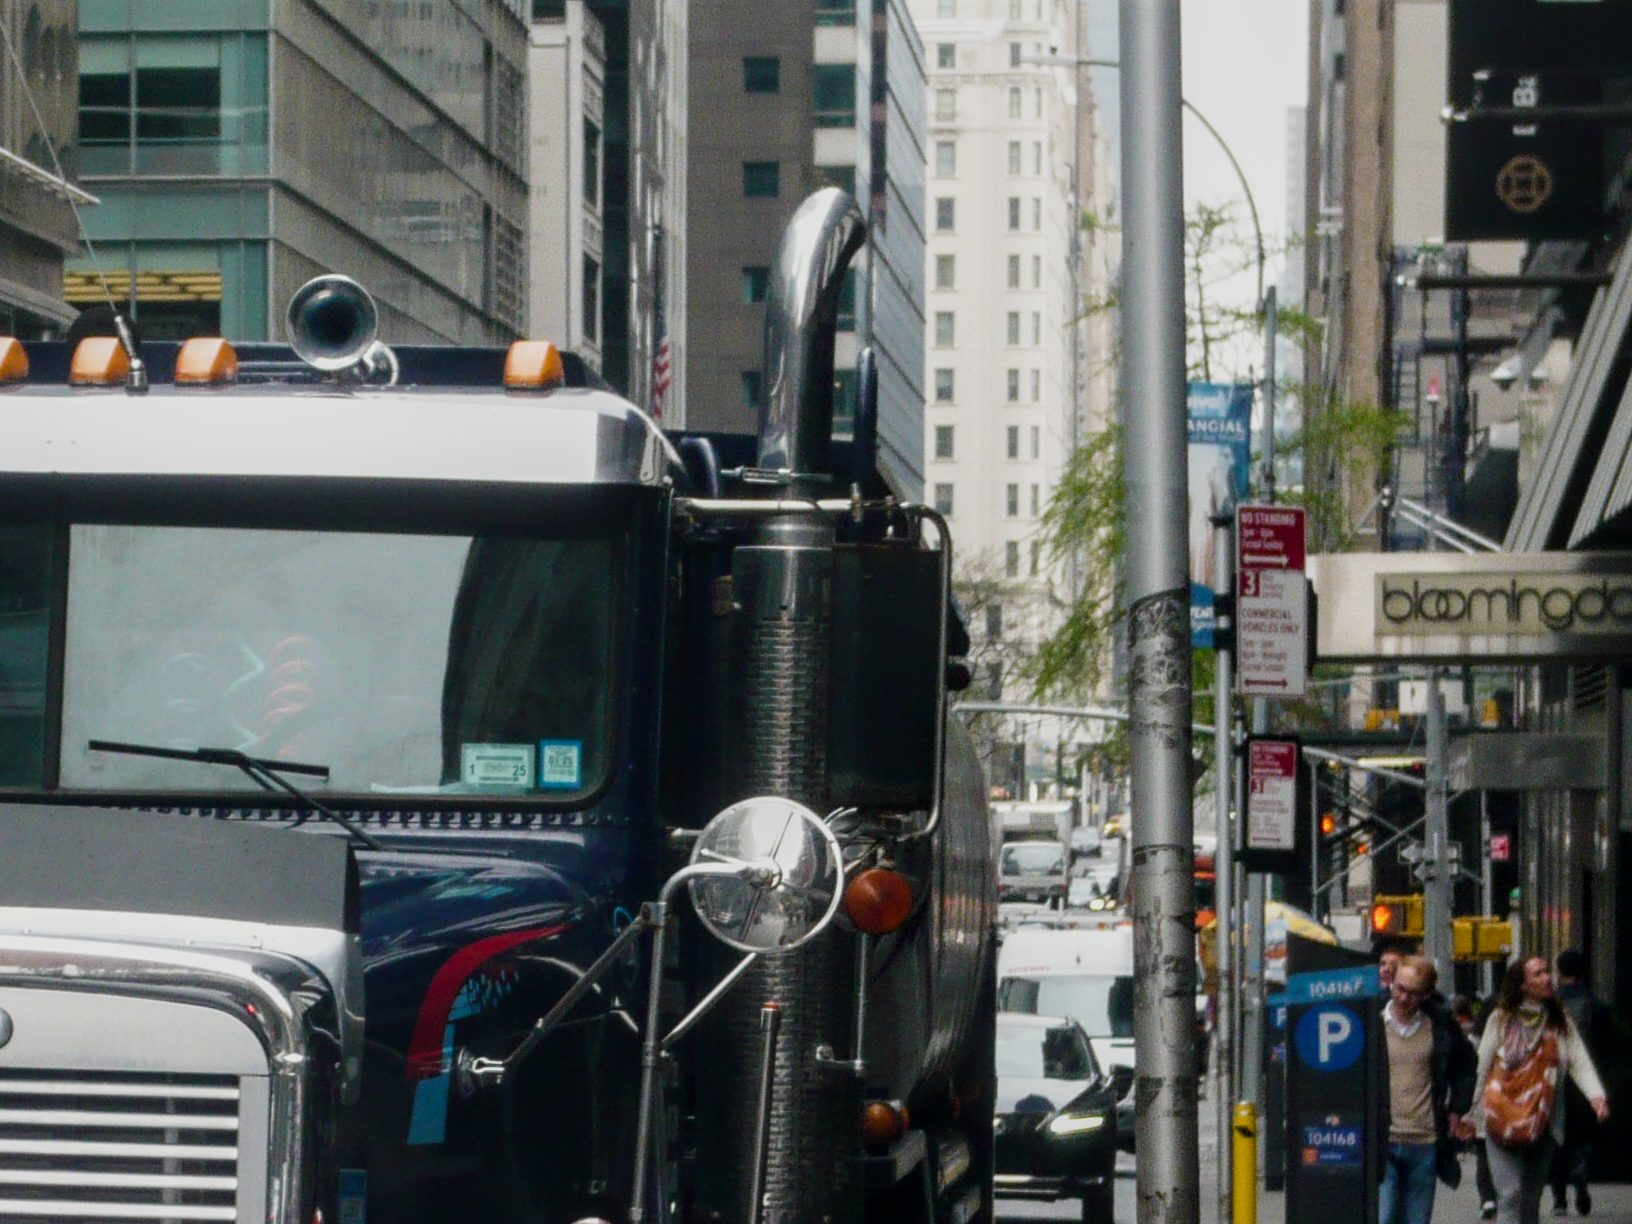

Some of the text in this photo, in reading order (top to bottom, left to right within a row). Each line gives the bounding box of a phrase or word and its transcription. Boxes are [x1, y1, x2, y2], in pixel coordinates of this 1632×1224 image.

[1187, 419, 1245, 434] ANCIAL
[1244, 570, 1256, 595] 3
[469, 764, 526, 776] 1 25
[1319, 1012, 1351, 1063] P
[1307, 1131, 1356, 1146] 104168
